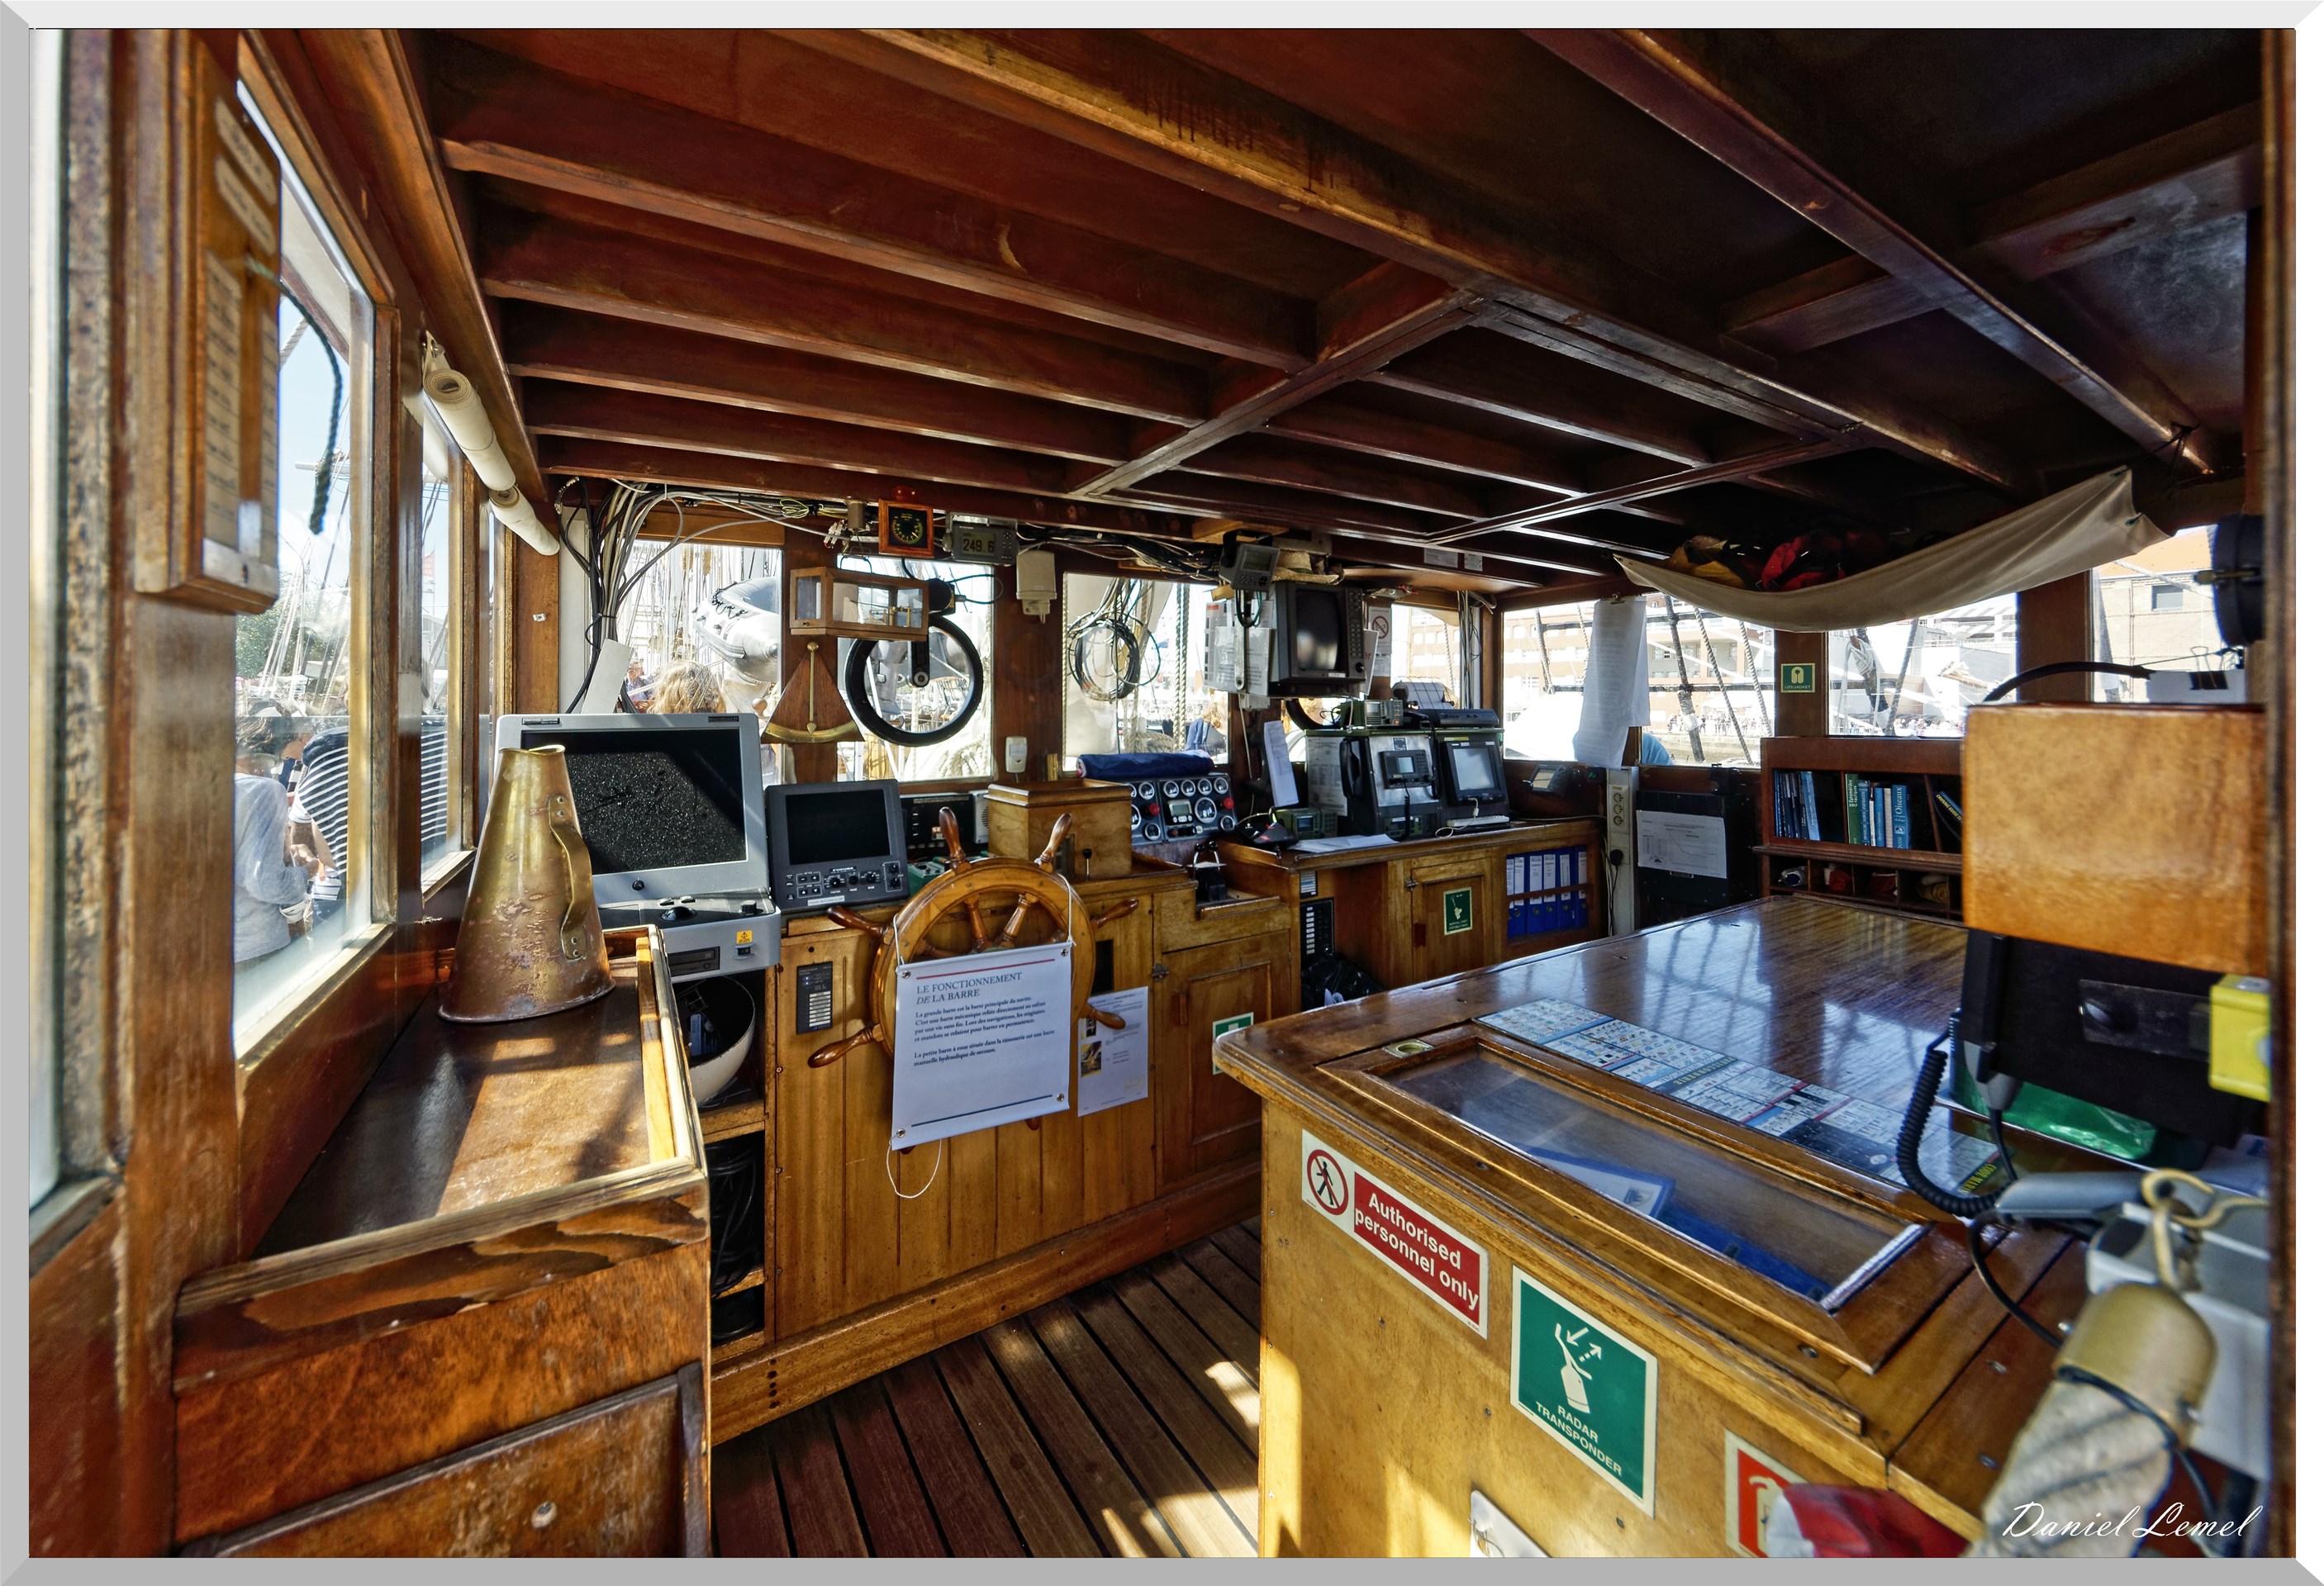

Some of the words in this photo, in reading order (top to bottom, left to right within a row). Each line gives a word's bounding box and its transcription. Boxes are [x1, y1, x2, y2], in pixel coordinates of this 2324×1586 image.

[917, 985, 929, 994] LE
[932, 972, 1022, 992] FONCTIONNEMENT
[916, 996, 930, 1004] DE
[932, 993, 945, 1002] LA
[948, 989, 980, 1000] BARRE
[924, 1009, 942, 1018] grande
[984, 999, 1008, 1009] principale
[954, 1012, 981, 1020] mécanique
[996, 1004, 1024, 1014] directement
[986, 1014, 1016, 1023] navigations,
[1024, 1009, 1045, 1017] stagiaires
[920, 1033, 943, 1042] matelots
[950, 1028, 969, 1036] relaient
[970, 1027, 982, 1035] pour
[1005, 1019, 1035, 1029] permanence.
[914, 1057, 939, 1066] manuelle
[939, 1052, 969, 1063] hydraulique
[977, 1047, 996, 1056] secours.
[922, 1048, 938, 1058] petite
[939, 1046, 953, 1054] barre
[969, 1041, 984, 1049] située
[984, 1038, 996, 1047] dans
[1002, 1034, 1025, 1043] timonerie
[1368, 1192, 1461, 1270] Authorised
[1355, 1207, 1435, 1278] personnel
[1439, 1269, 1479, 1311] only
[1557, 1405, 1599, 1443] RADAR
[1535, 1401, 1622, 1476] TRANSPONDER
